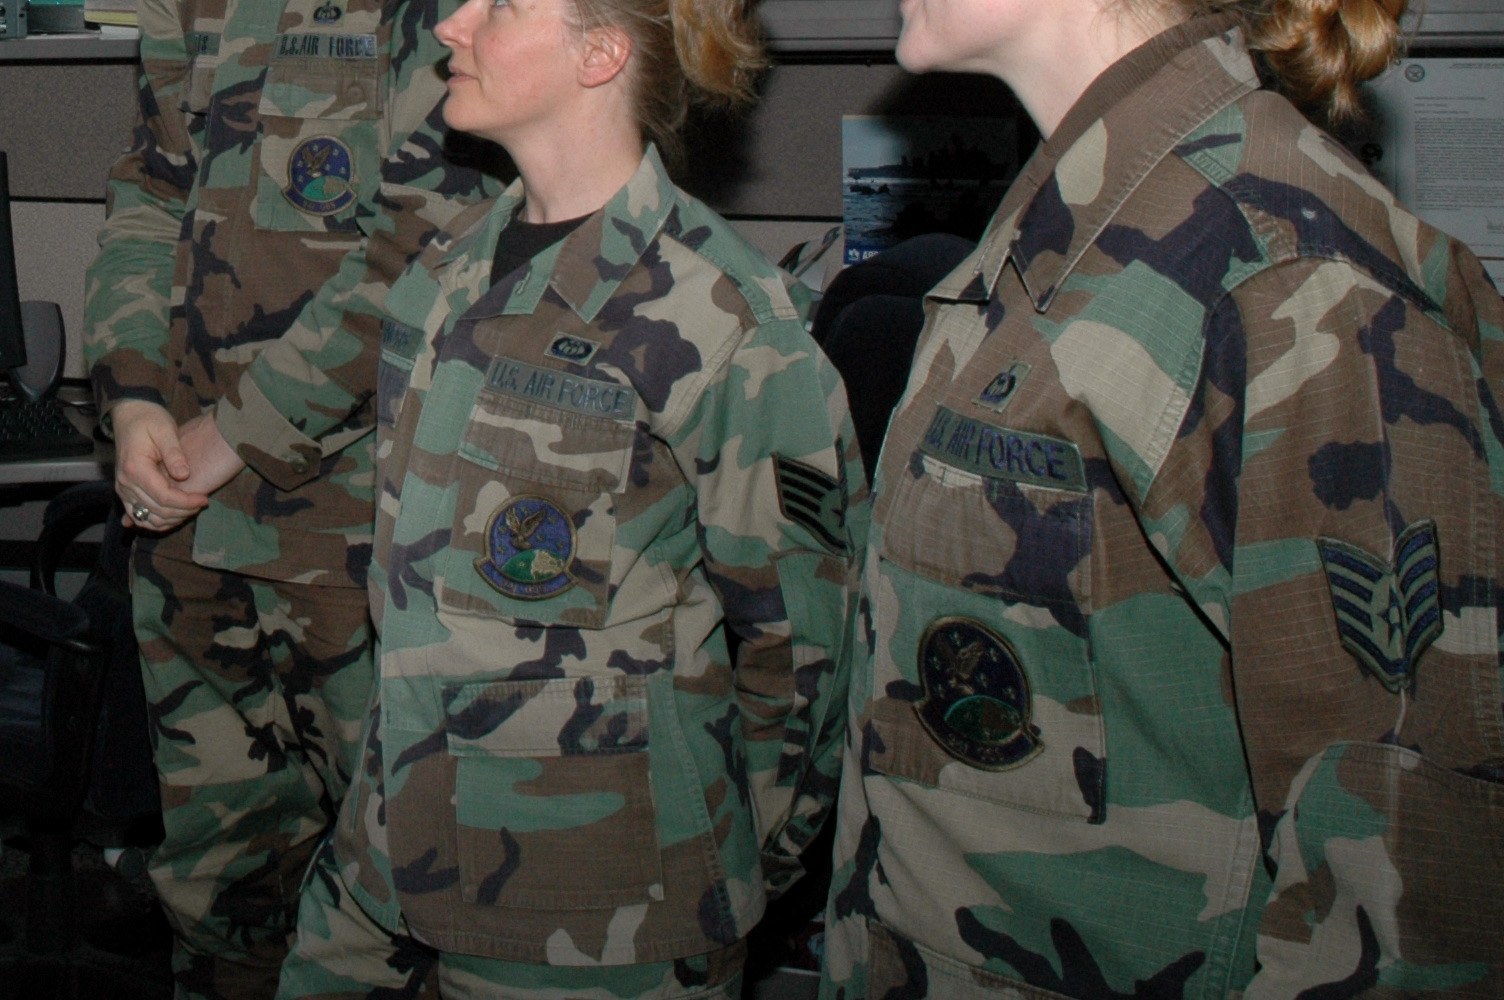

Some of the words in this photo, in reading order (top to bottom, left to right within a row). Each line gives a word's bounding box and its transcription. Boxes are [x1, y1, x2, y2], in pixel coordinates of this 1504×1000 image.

[329, 34, 375, 58] FORCE
[523, 370, 556, 397] AIR
[557, 377, 632, 414] FORCE
[945, 420, 976, 461] AIR
[975, 427, 1066, 482] FORCE
